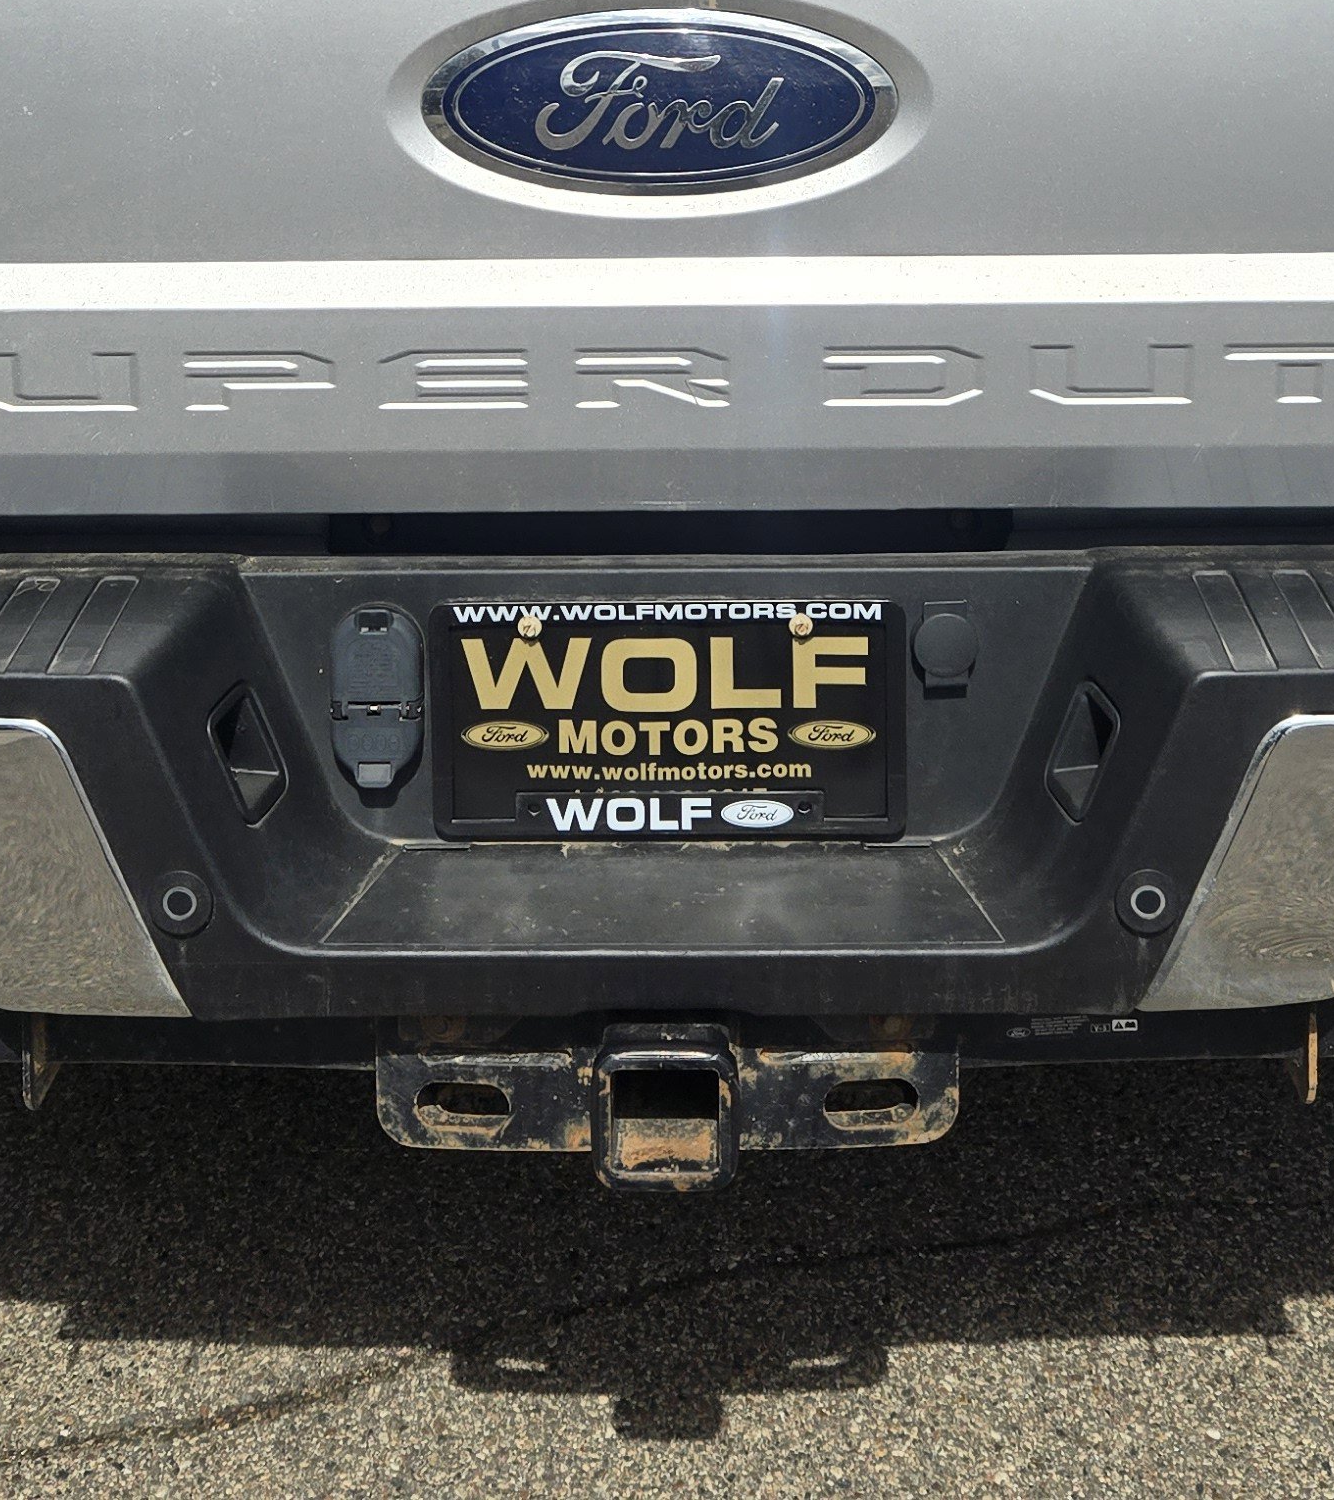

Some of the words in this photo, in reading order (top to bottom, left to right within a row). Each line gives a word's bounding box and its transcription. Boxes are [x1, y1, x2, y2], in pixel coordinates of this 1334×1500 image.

[534, 50, 785, 150] Ford
[453, 603, 883, 623] WWW.WOLFMOTORSCOM
[460, 636, 869, 712] WOLF
[480, 725, 529, 744] Ford
[558, 718, 779, 755] MOTORS
[808, 725, 856, 744] Ford
[526, 761, 812, 781] www.wolfmotors.com
[546, 797, 712, 831] WOLF
[736, 804, 778, 822] Ford
